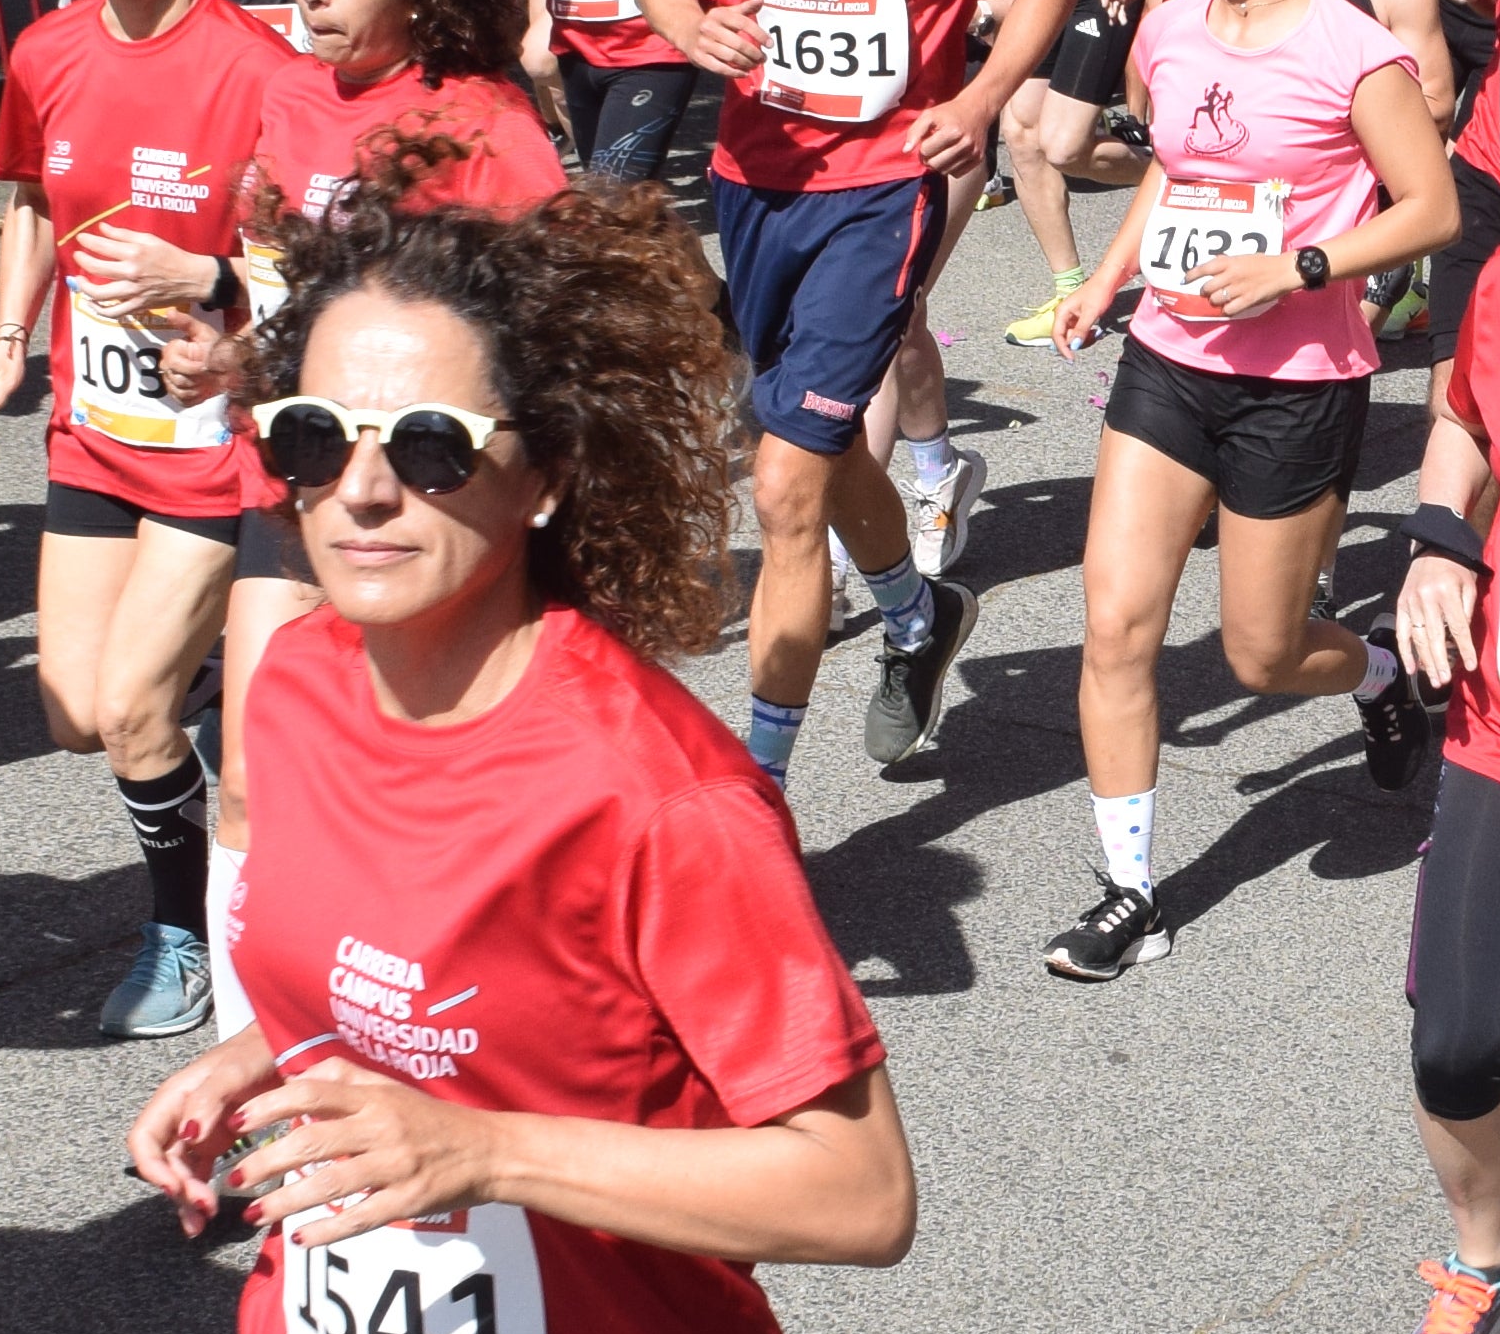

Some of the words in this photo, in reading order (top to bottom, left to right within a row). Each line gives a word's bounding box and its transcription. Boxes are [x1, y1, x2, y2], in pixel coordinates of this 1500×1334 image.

[768, 24, 897, 78] 1631
[131, 161, 182, 182] CAMPUS
[132, 146, 188, 167] CARRERA
[131, 177, 209, 200] UNIVERSIDAD
[131, 191, 145, 208] DE
[146, 193, 161, 210] LA
[162, 195, 197, 213] RIOJA
[336, 935, 427, 992] CARRERA
[328, 966, 413, 1020] CAMPUS
[329, 996, 480, 1055] UNIVERSIDAD
[386, 1048, 459, 1080] RIOJA
